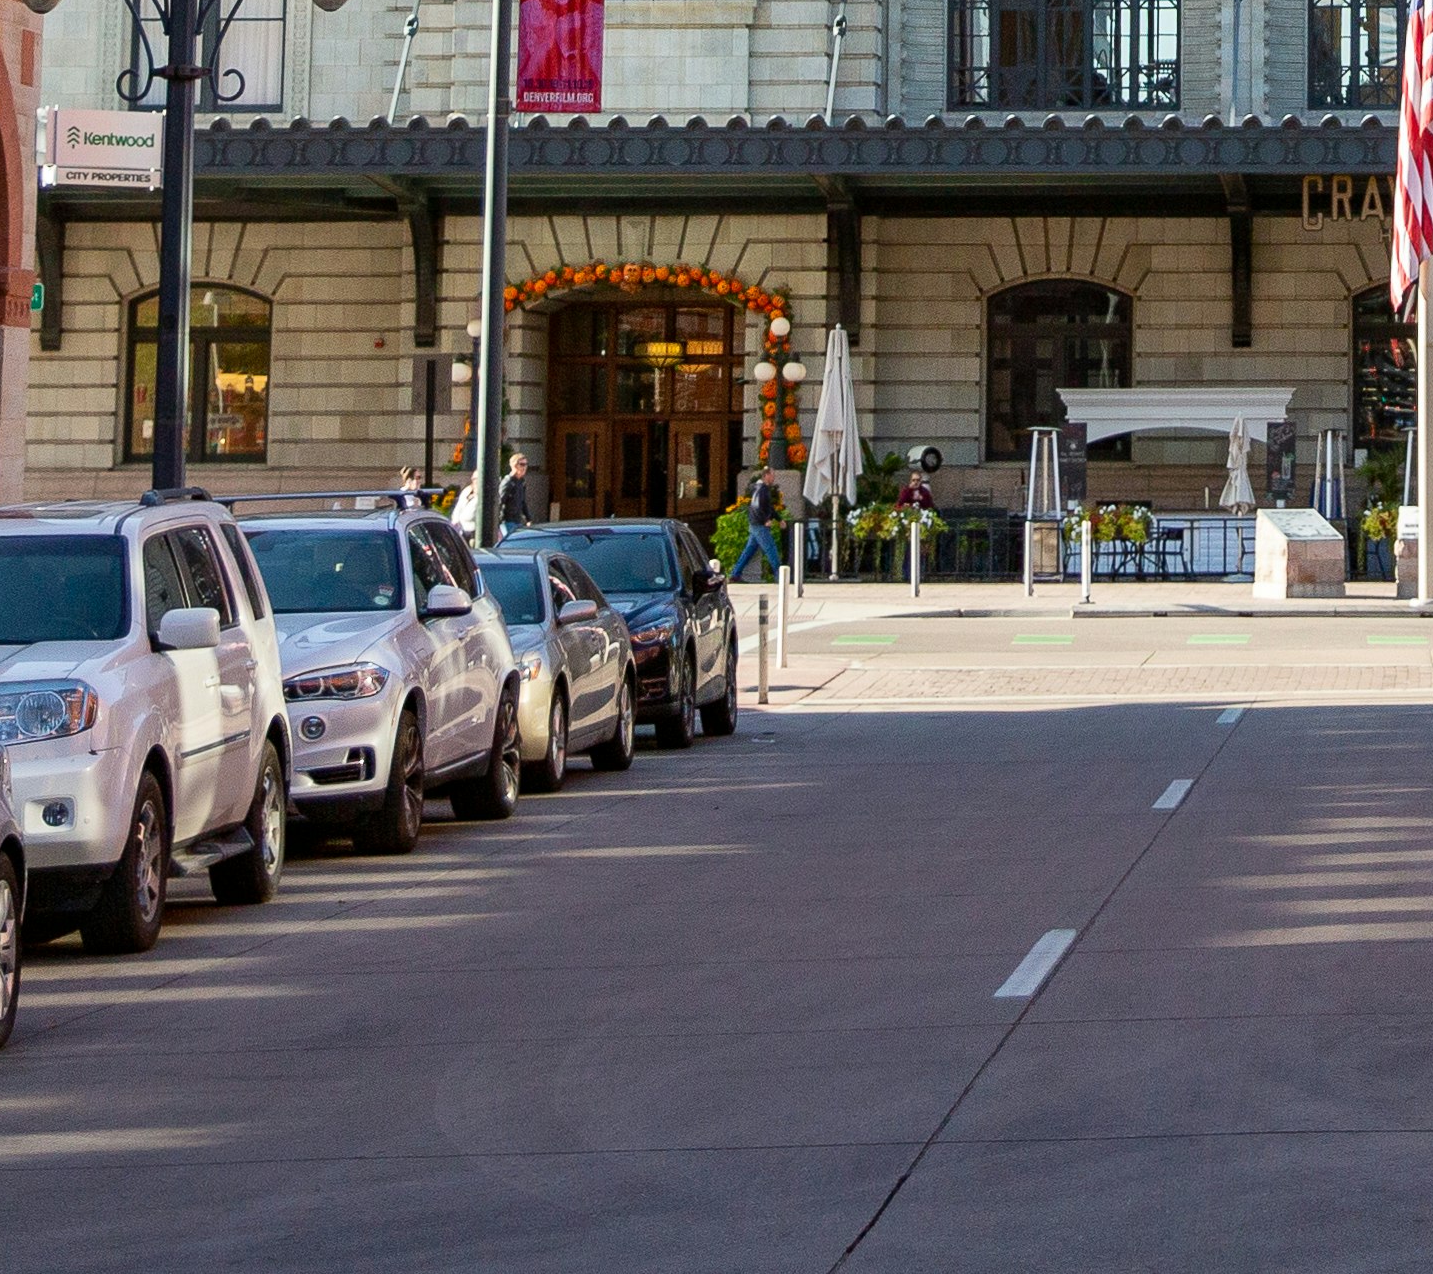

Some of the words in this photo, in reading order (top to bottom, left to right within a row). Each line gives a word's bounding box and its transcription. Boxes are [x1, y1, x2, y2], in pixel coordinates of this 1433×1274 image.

[83, 132, 155, 148] Kentwood
[66, 171, 90, 181] CITY
[91, 172, 152, 183] PROPERTIES
